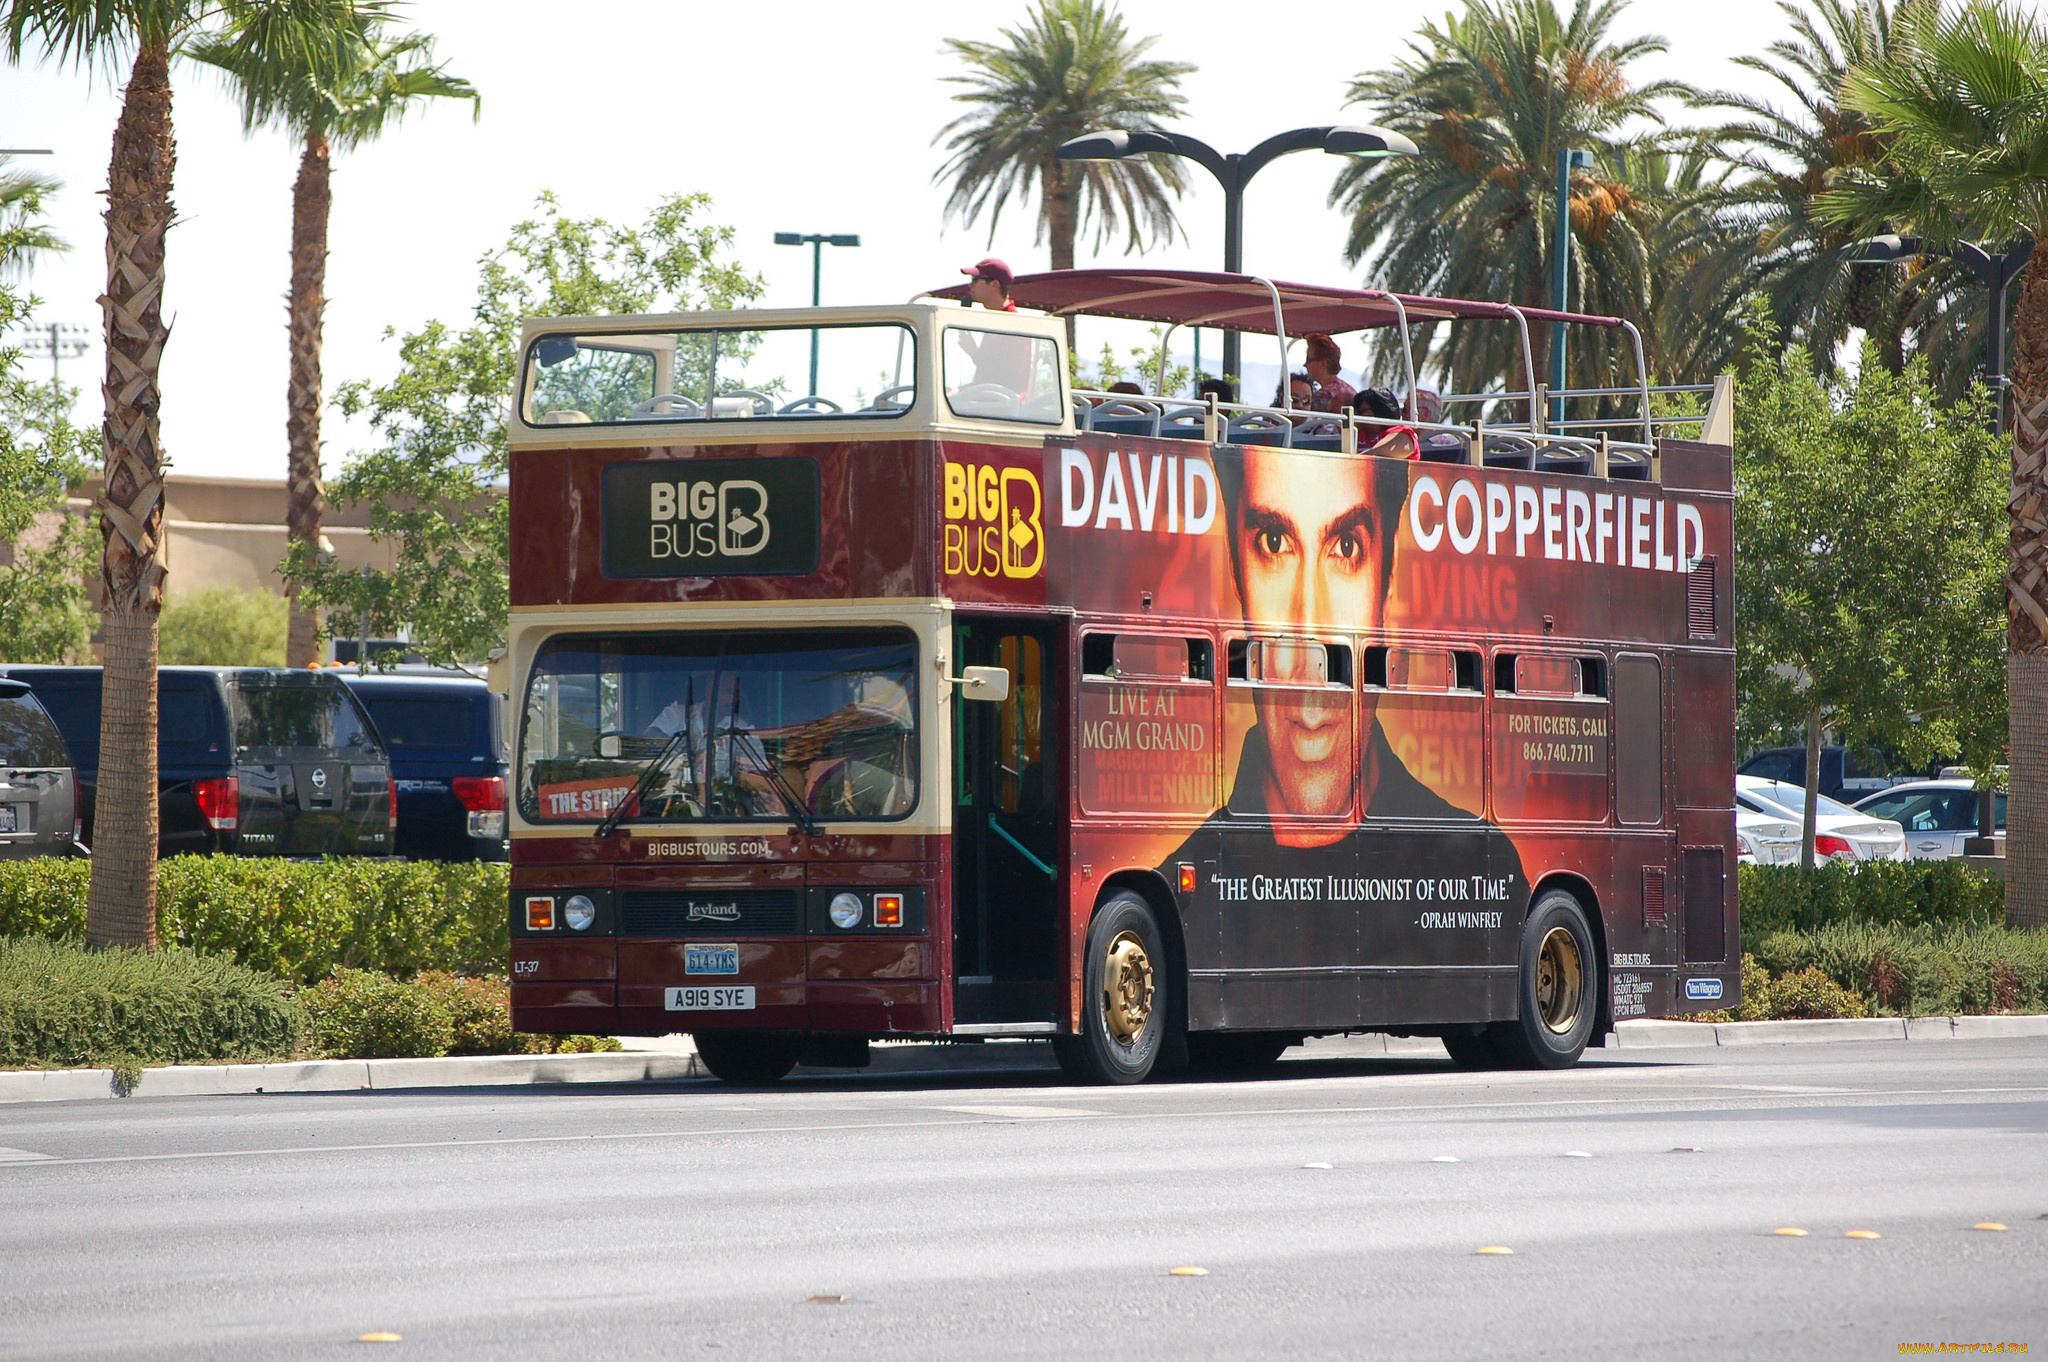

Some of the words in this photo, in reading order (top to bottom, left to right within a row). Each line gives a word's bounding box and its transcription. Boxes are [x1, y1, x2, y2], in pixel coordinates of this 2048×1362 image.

[651, 481, 716, 521] BIG
[944, 461, 1000, 522] BIG
[1061, 448, 1217, 535] DAVID
[1410, 474, 1704, 574] COPPERFIELD
[651, 522, 716, 558] BUS
[944, 524, 1000, 577] BUS
[1108, 686, 1149, 716] LIVE
[1153, 688, 1179, 717] AT
[1082, 720, 1131, 750] MGM
[1136, 721, 1204, 752] GRAND
[1509, 714, 1531, 733] FOR
[1533, 715, 1580, 737] TICKETS,
[1582, 718, 1608, 737] CALL
[1523, 741, 1595, 763] 866.740.7711
[548, 791, 579, 815] THE
[581, 786, 629, 812] STRIP
[242, 833, 275, 843] TITAN
[648, 842, 769, 856] BIGBUSTOURS.COM
[1252, 874, 1323, 901] GREATEST
[1327, 875, 1412, 901] ILLUSIONIST
[1416, 878, 1435, 901] OF
[1438, 878, 1469, 901] OUR
[686, 902, 741, 921] Leyland
[1457, 911, 1503, 929] WINFREY
[514, 960, 539, 973] LT-37
[1613, 953, 1622, 965] BIG
[1623, 953, 1633, 965] BUS
[1633, 953, 1651, 965] TOURS
[675, 989, 709, 1007] A919
[714, 989, 745, 1006] SYE
[1688, 983, 1699, 994] Van
[1699, 983, 1721, 997] Wagner
